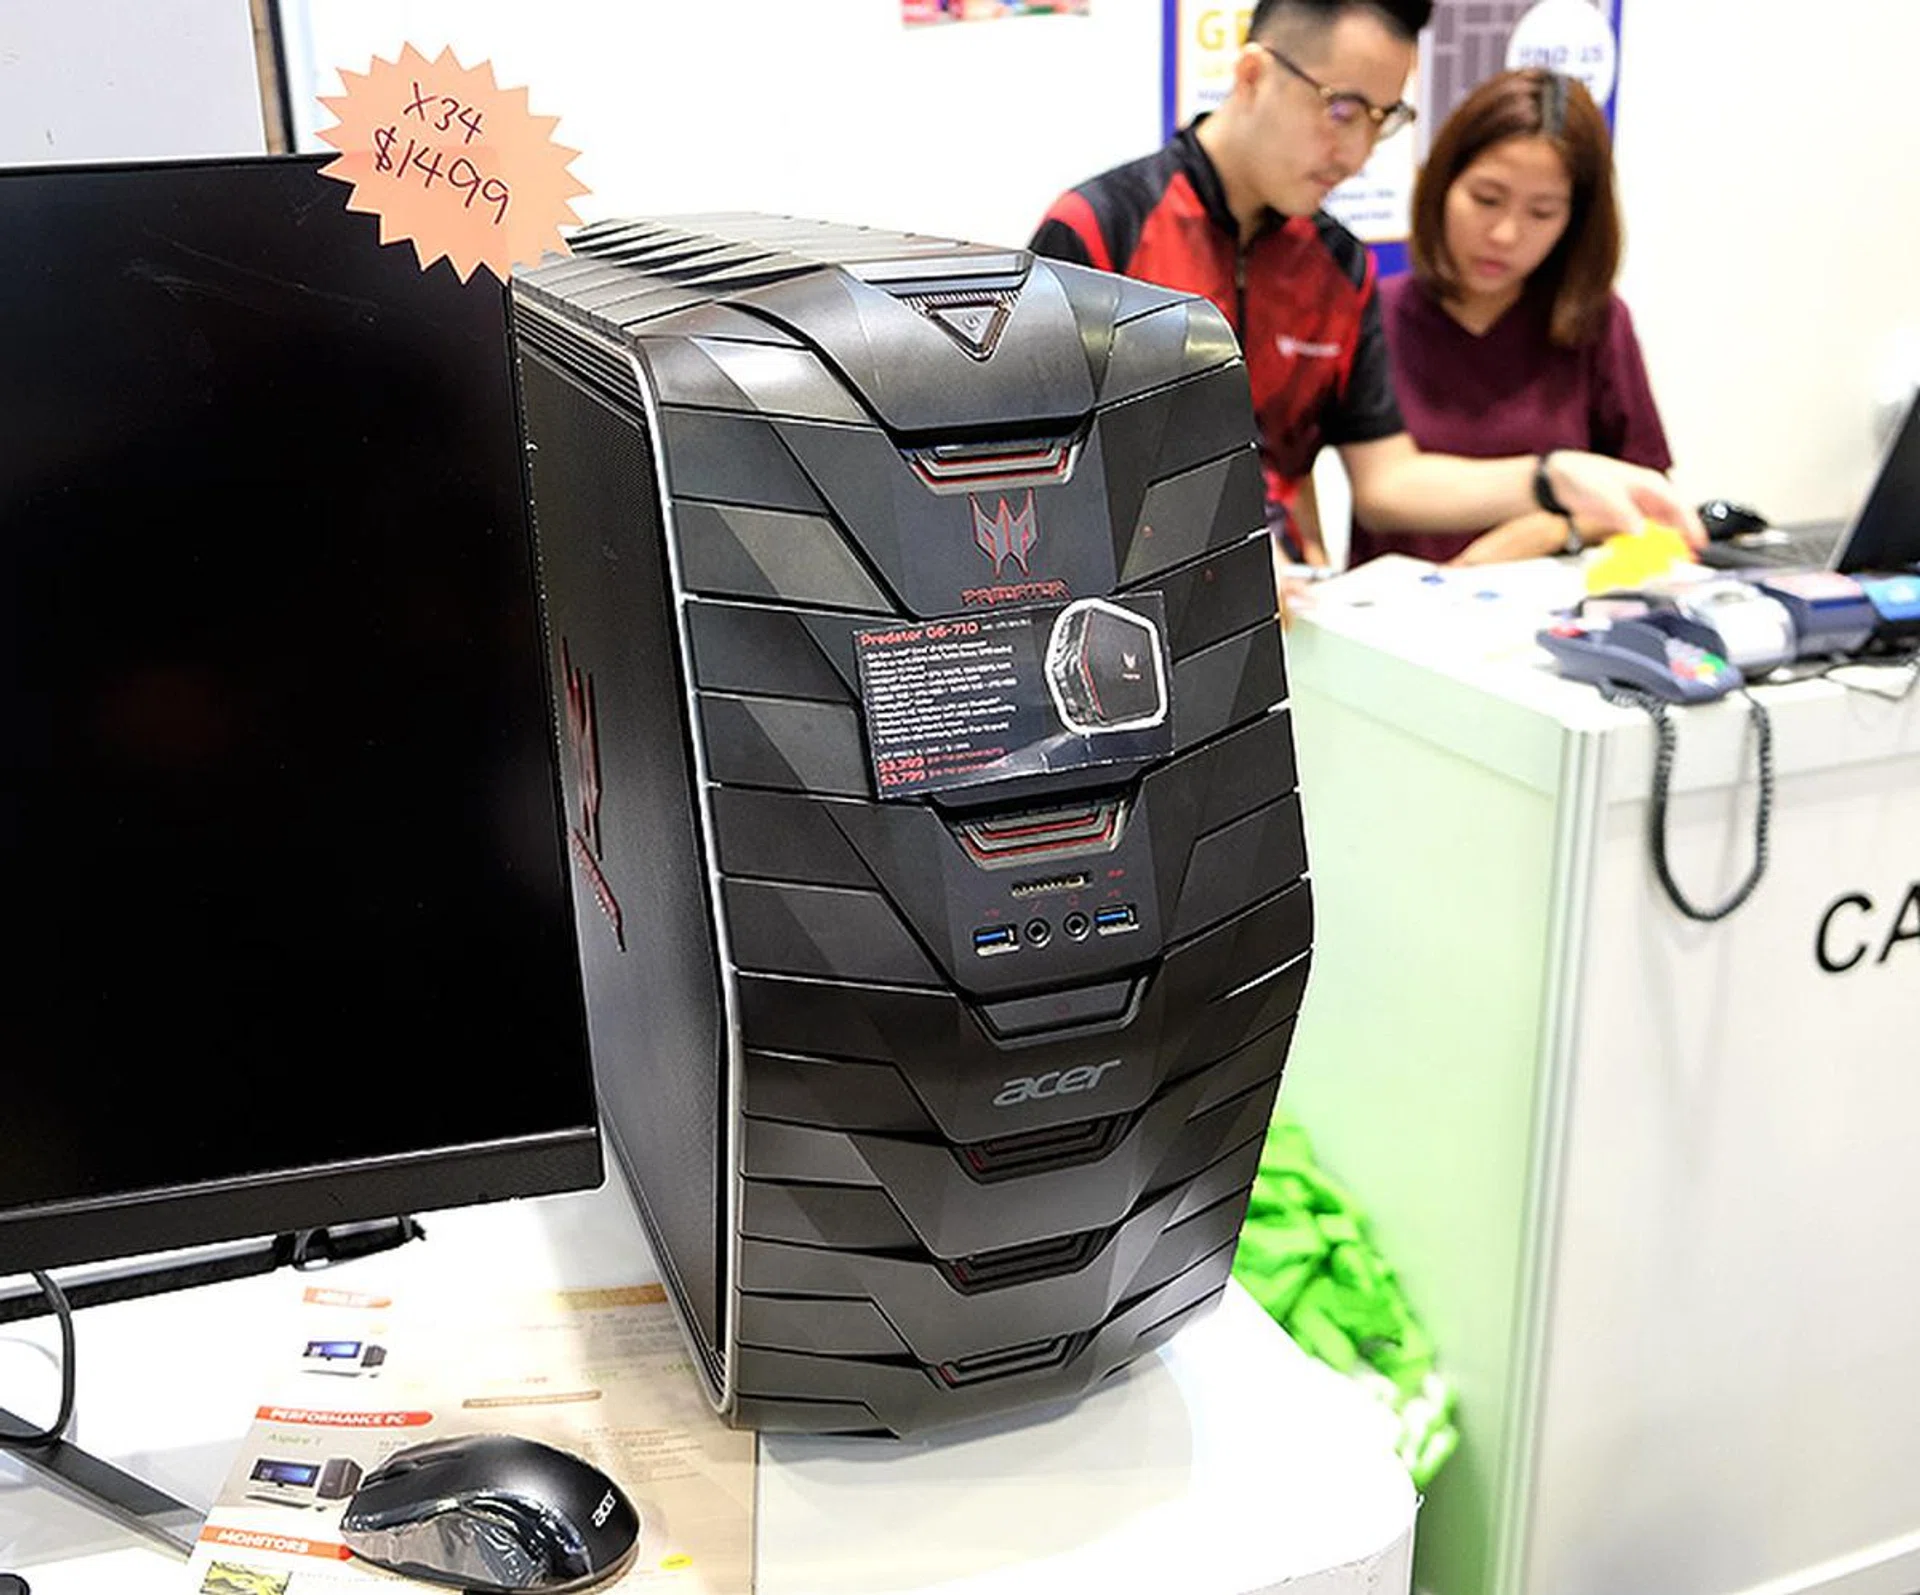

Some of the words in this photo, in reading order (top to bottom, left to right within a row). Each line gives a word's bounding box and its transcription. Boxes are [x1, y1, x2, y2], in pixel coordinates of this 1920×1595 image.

[403, 82, 483, 144] X34
[374, 126, 509, 225] $1499
[860, 629, 923, 646] Predator
[993, 1058, 1122, 1106] acer
[269, 1408, 383, 1425] PERFORMANCE
[385, 1414, 407, 1425] PC
[591, 1489, 616, 1527] acer
[217, 1529, 309, 1553] MONITORS
